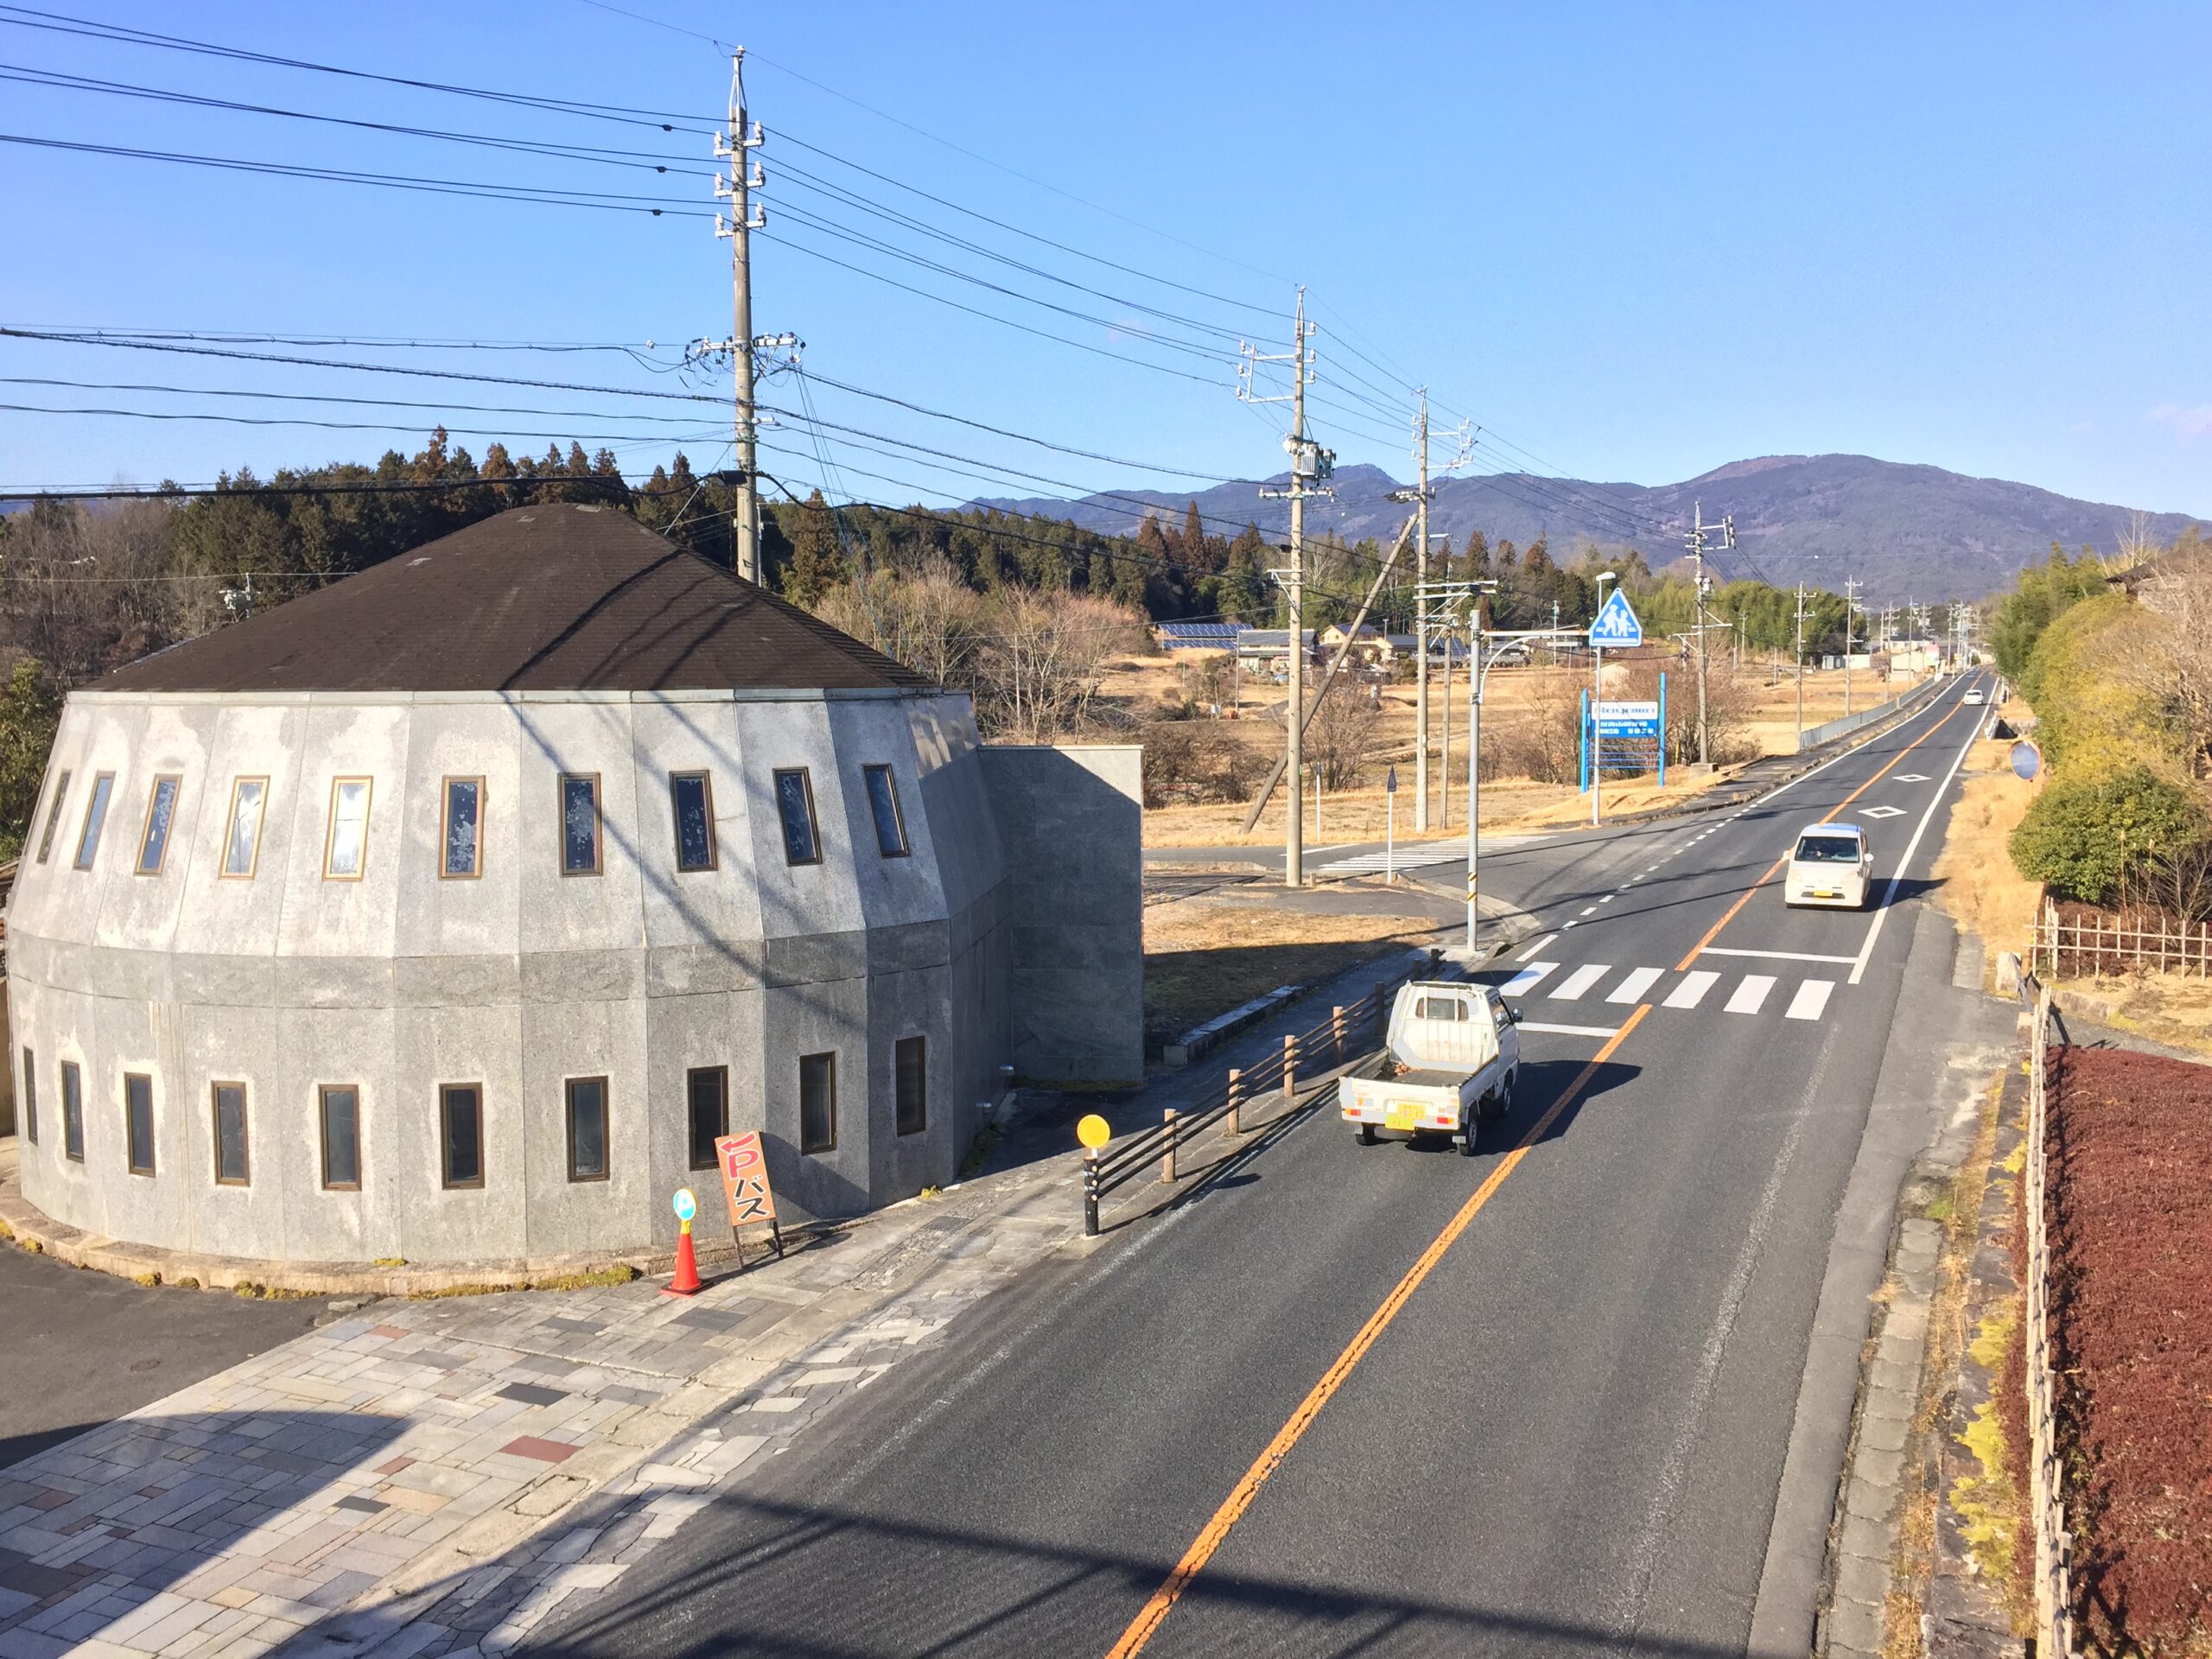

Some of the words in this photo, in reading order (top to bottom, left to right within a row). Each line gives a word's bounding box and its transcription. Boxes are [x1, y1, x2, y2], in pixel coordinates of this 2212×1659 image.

[728, 1149, 760, 1179] P
[677, 1192, 693, 1216] P
[734, 1175, 770, 1221] バス
